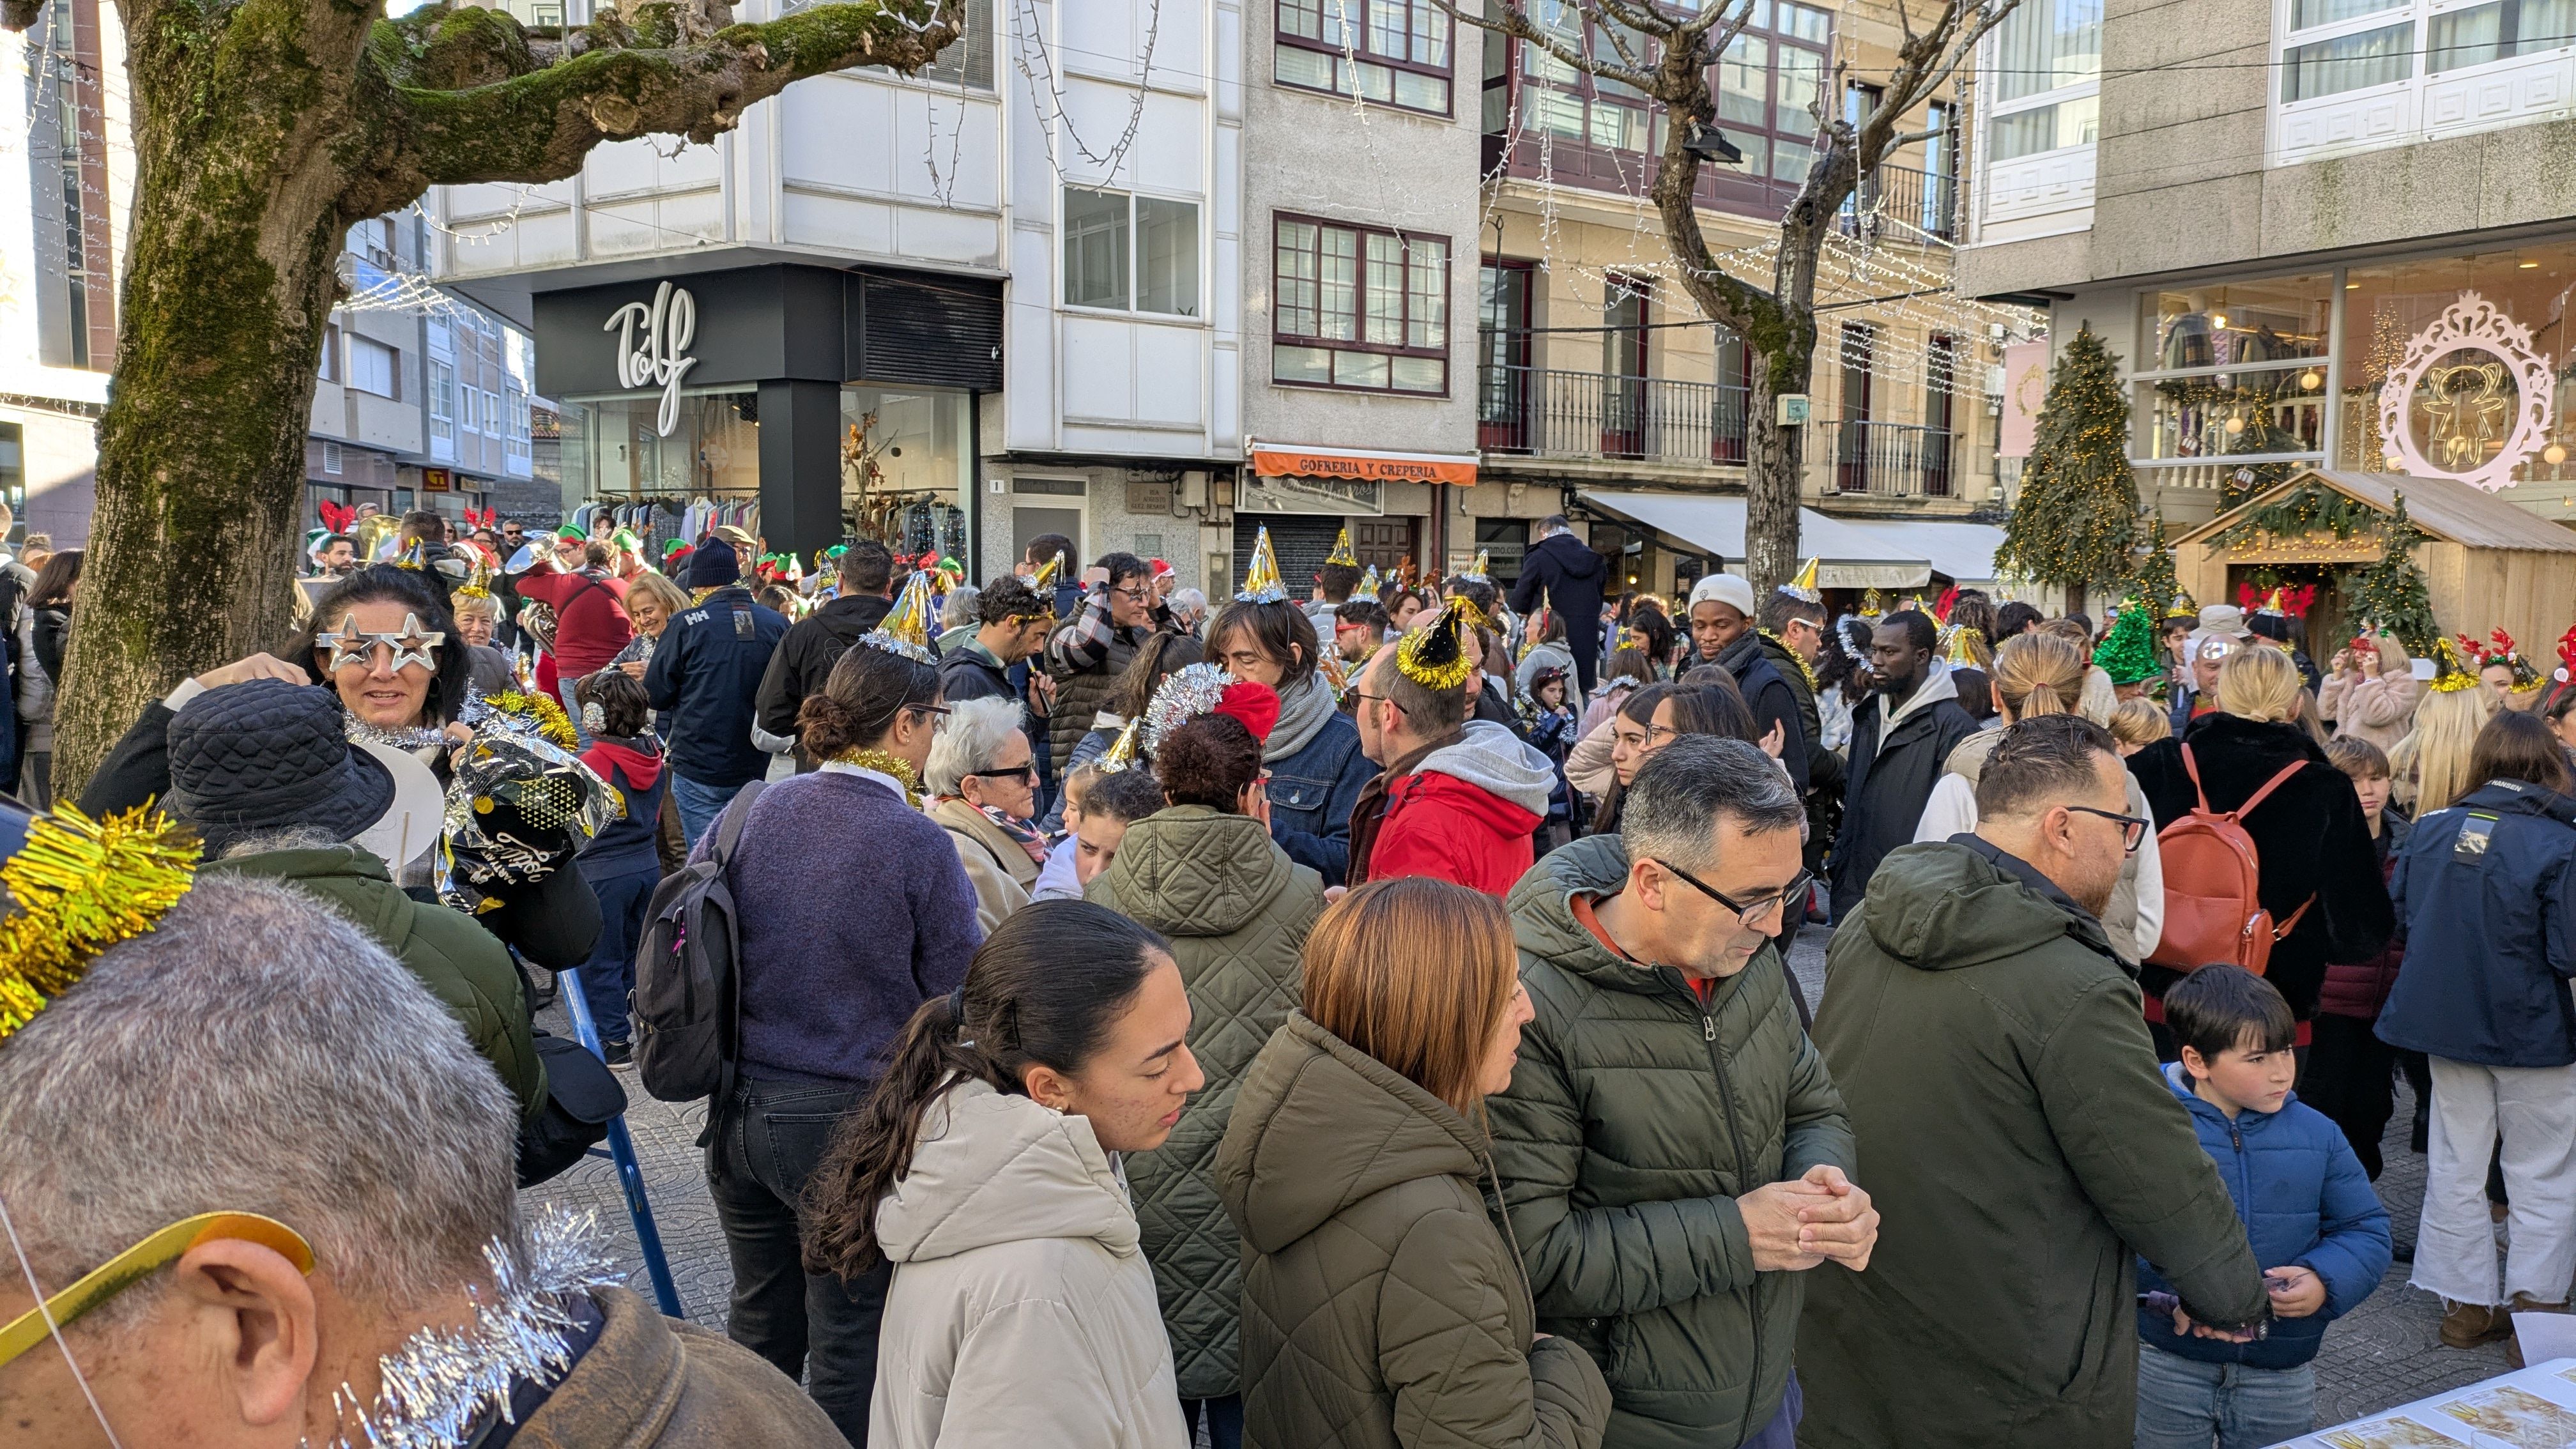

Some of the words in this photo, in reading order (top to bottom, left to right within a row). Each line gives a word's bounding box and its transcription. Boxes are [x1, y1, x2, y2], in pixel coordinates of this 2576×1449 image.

[1300, 459, 1361, 474] GOFRERIA
[1367, 463, 1375, 475] Y
[1379, 463, 1437, 478] CREPERIA
[684, 610, 710, 626] HH
[2492, 779, 2522, 792] HANSEN
[490, 861, 516, 884] PARTY
